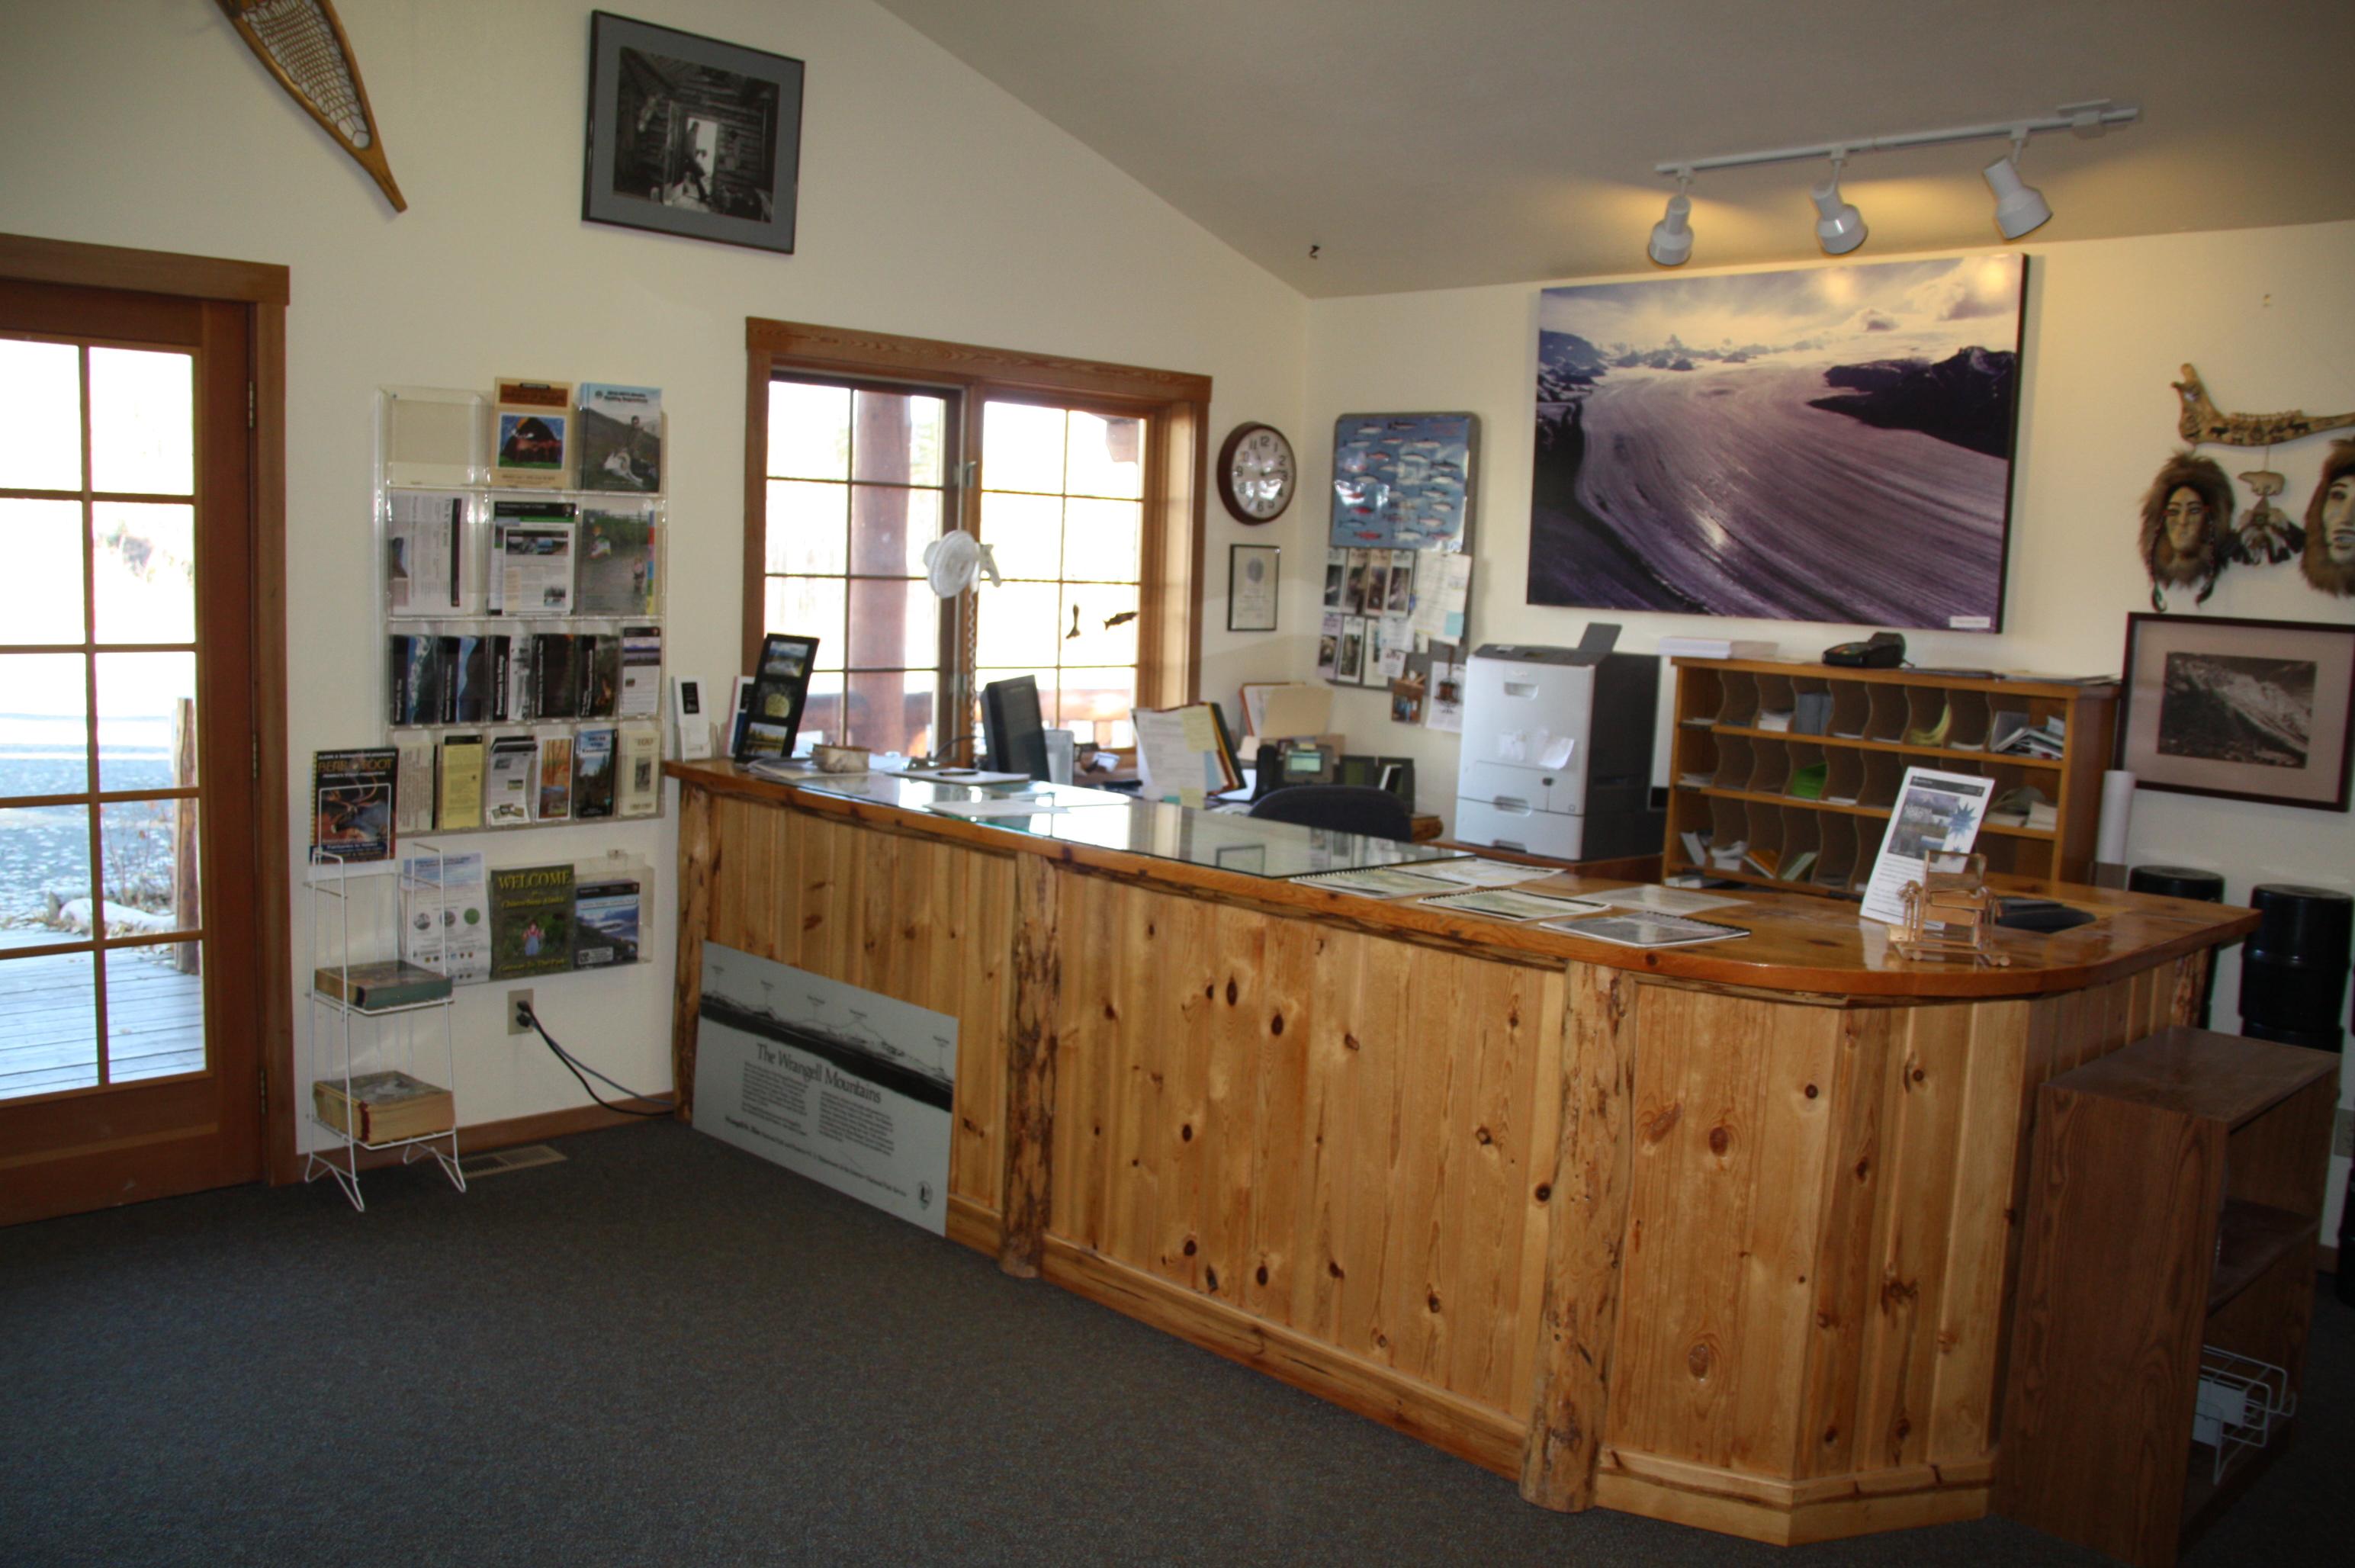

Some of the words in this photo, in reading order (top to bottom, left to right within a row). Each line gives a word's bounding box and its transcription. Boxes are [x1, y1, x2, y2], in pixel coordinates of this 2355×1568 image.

[1249, 439, 1258, 450] 11
[1260, 435, 1270, 446] 12
[1274, 442, 1277, 451] 1
[1278, 455, 1287, 465] 2
[1235, 465, 1244, 477] 9
[1280, 470, 1288, 481] 3
[1256, 501, 1264, 512] 6
[498, 870, 571, 890] WELCOME
[757, 1042, 776, 1065] The
[778, 1049, 823, 1084] Wrangell
[824, 1066, 882, 1104] Mountains
